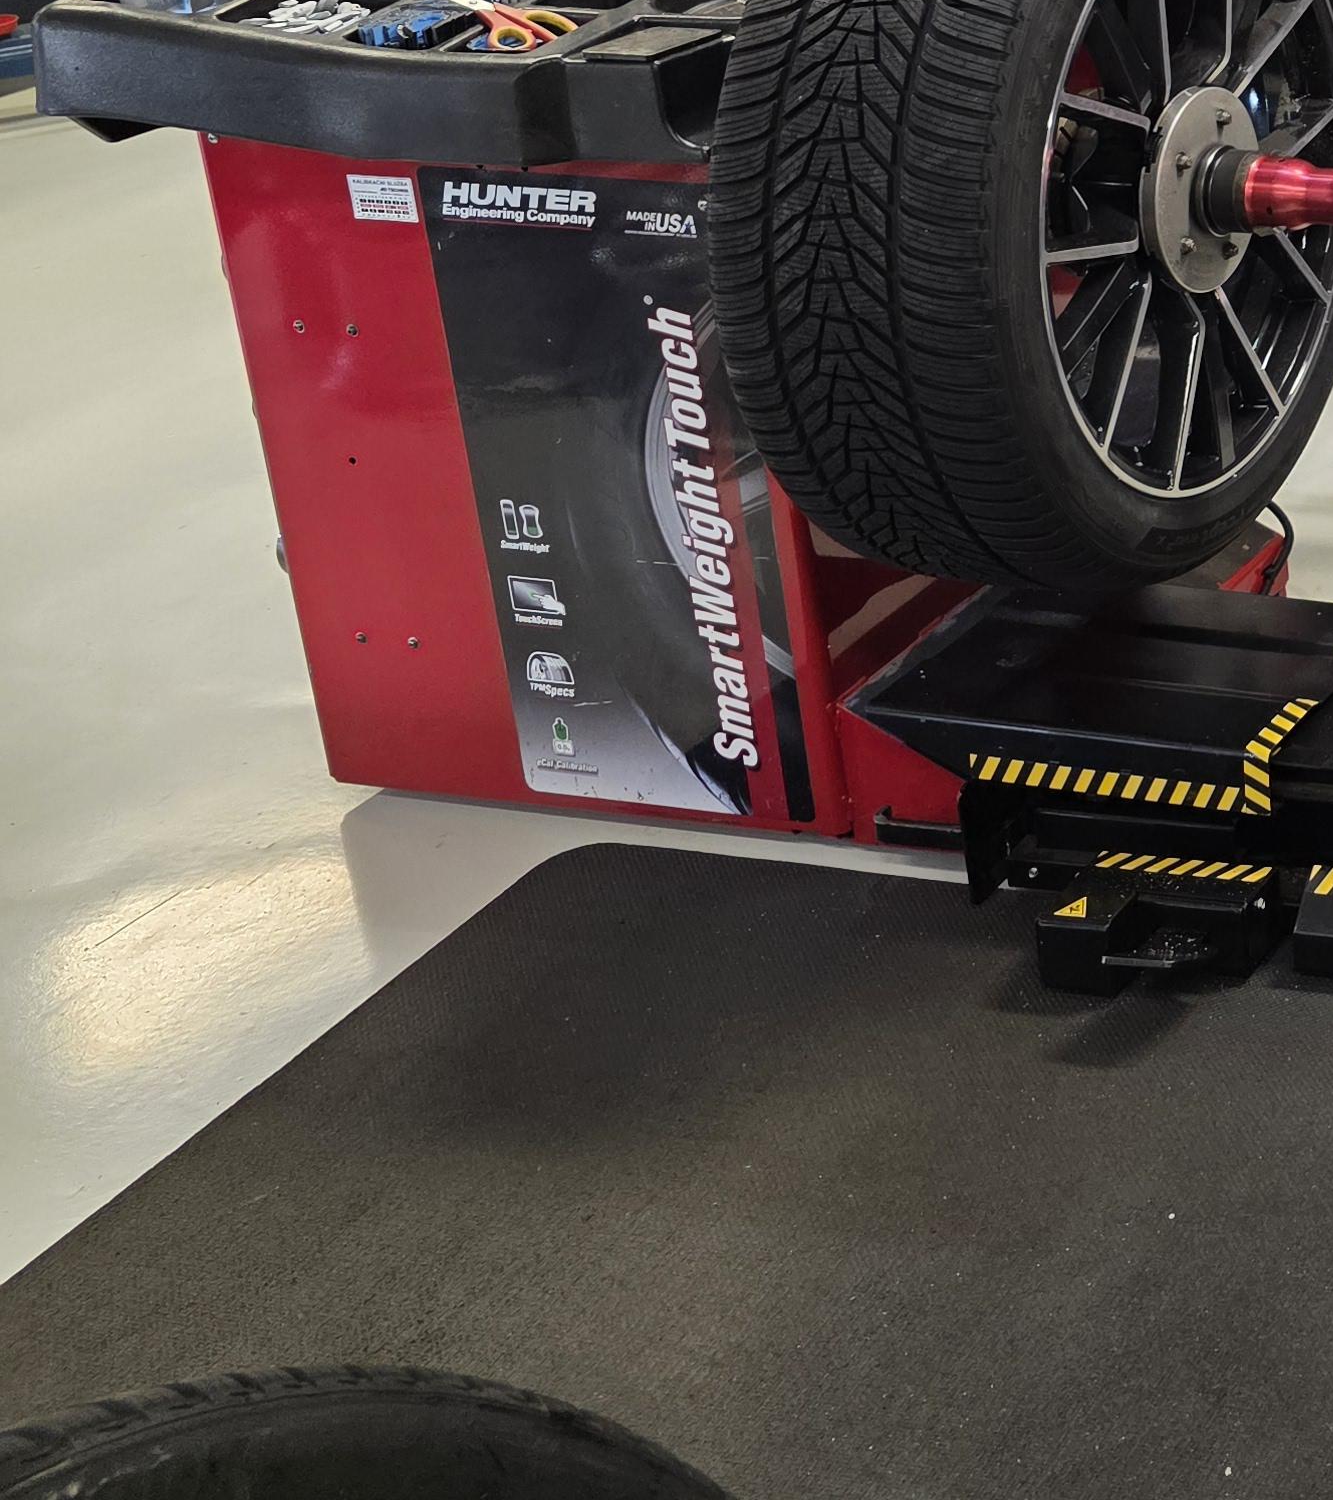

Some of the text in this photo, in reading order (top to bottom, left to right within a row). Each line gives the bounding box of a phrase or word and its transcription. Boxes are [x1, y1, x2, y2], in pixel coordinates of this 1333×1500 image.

[443, 181, 597, 212] HUNTER
[442, 203, 596, 228] Engineering Company
[626, 211, 656, 222] MADE
[645, 222, 655, 232] IN
[655, 212, 697, 235] USA
[647, 305, 711, 450] Touch
[673, 453, 759, 768] SmartWeight
